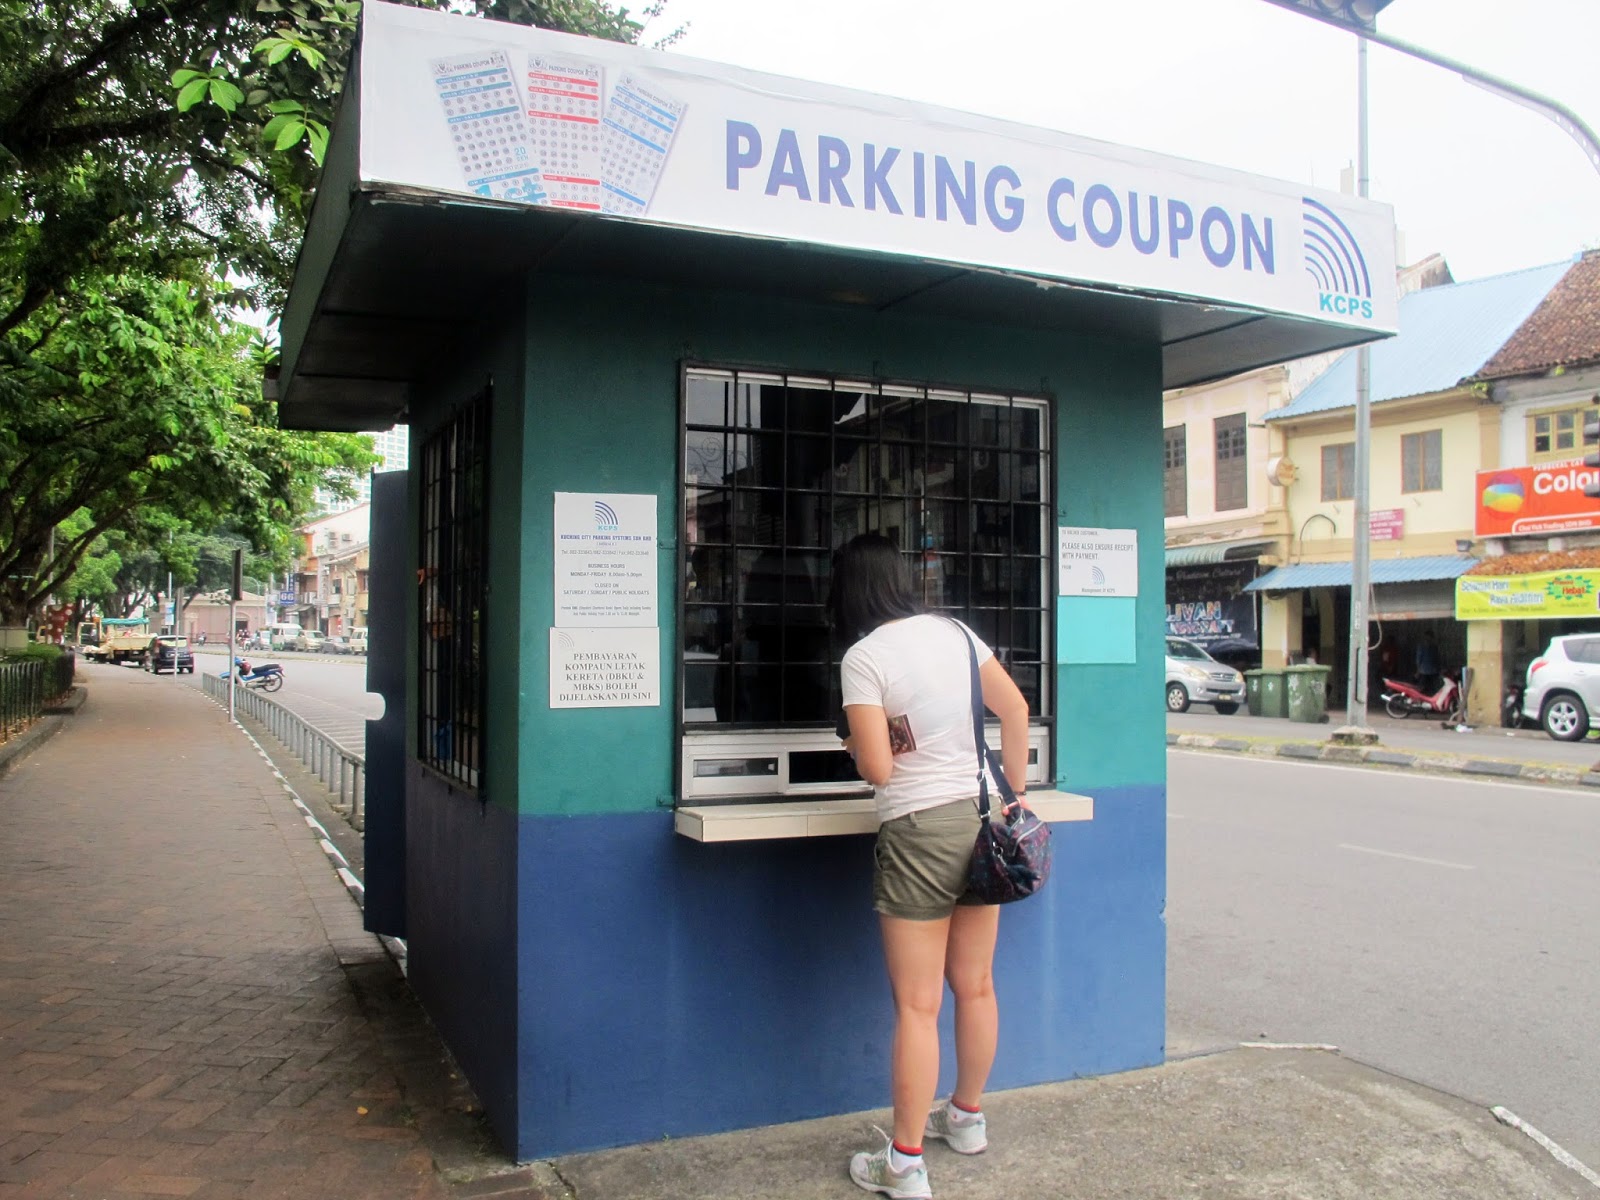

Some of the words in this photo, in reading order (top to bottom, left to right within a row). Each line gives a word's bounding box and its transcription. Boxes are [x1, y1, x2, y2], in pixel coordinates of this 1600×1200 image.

[515, 146, 526, 155] 20
[726, 119, 1025, 233] PARKING
[1047, 177, 1275, 275] COUPON
[1319, 292, 1373, 319] KCPS
[1081, 543, 1094, 551] ALSO
[573, 652, 637, 660] PEMBAYARAN
[565, 663, 613, 671] KOMPAUN
[615, 662, 646, 670] LETAK
[566, 673, 604, 681] KERETA
[605, 673, 635, 681] (DBKU
[573, 683, 604, 691] MBKS)
[605, 682, 638, 690] BOLEH
[559, 693, 618, 701] DIJELASKAN
[632, 692, 651, 700] SINI
